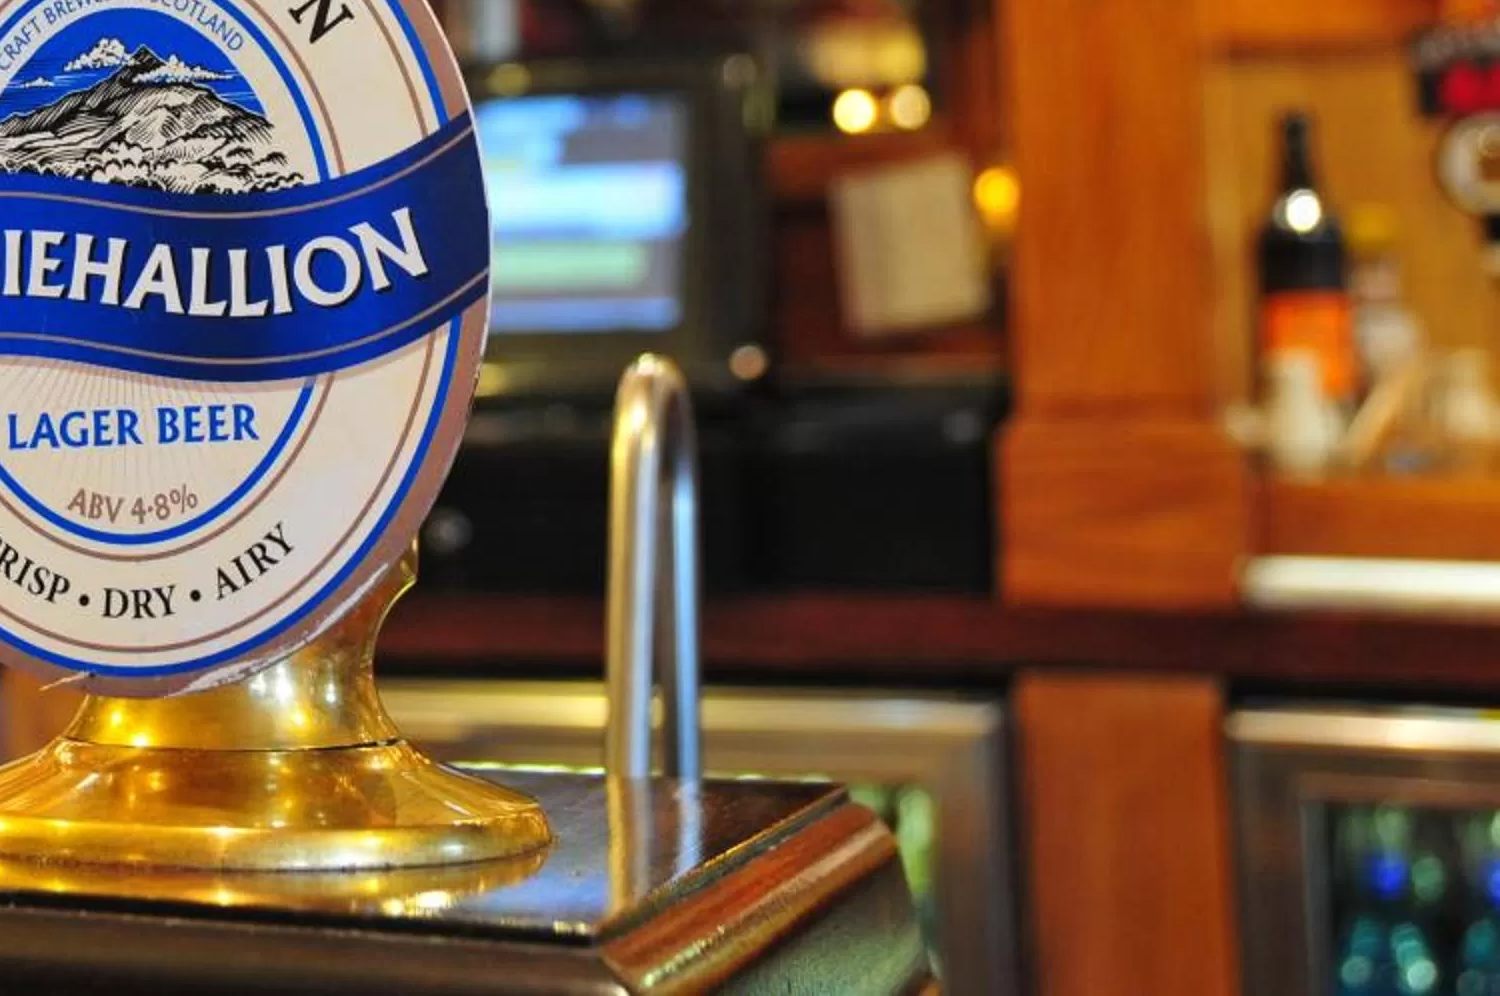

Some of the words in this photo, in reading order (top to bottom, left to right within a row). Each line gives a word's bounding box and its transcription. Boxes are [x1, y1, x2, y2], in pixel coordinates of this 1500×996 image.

[8, 409, 142, 450] LAGER
[157, 404, 259, 444] BEER
[68, 488, 125, 524] ABV
[102, 584, 176, 619] DRY
[215, 521, 295, 600] AIRY
